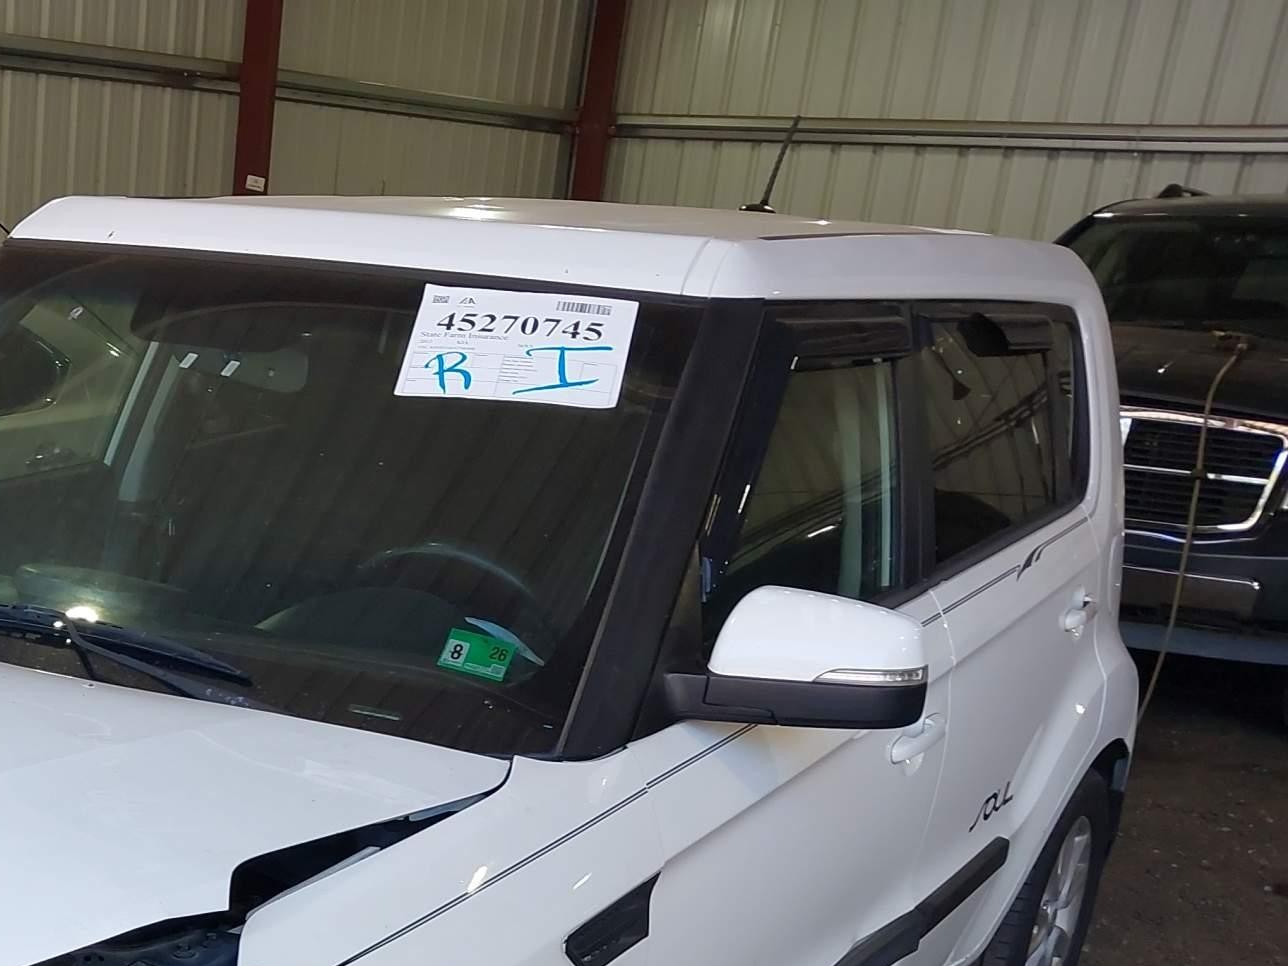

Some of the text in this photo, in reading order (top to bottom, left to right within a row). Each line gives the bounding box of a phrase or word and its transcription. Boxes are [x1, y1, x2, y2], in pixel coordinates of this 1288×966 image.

[436, 311, 605, 342] 45270745
[423, 351, 472, 395] R
[512, 346, 613, 395] I
[450, 643, 464, 660] 8
[488, 646, 509, 662] 26
